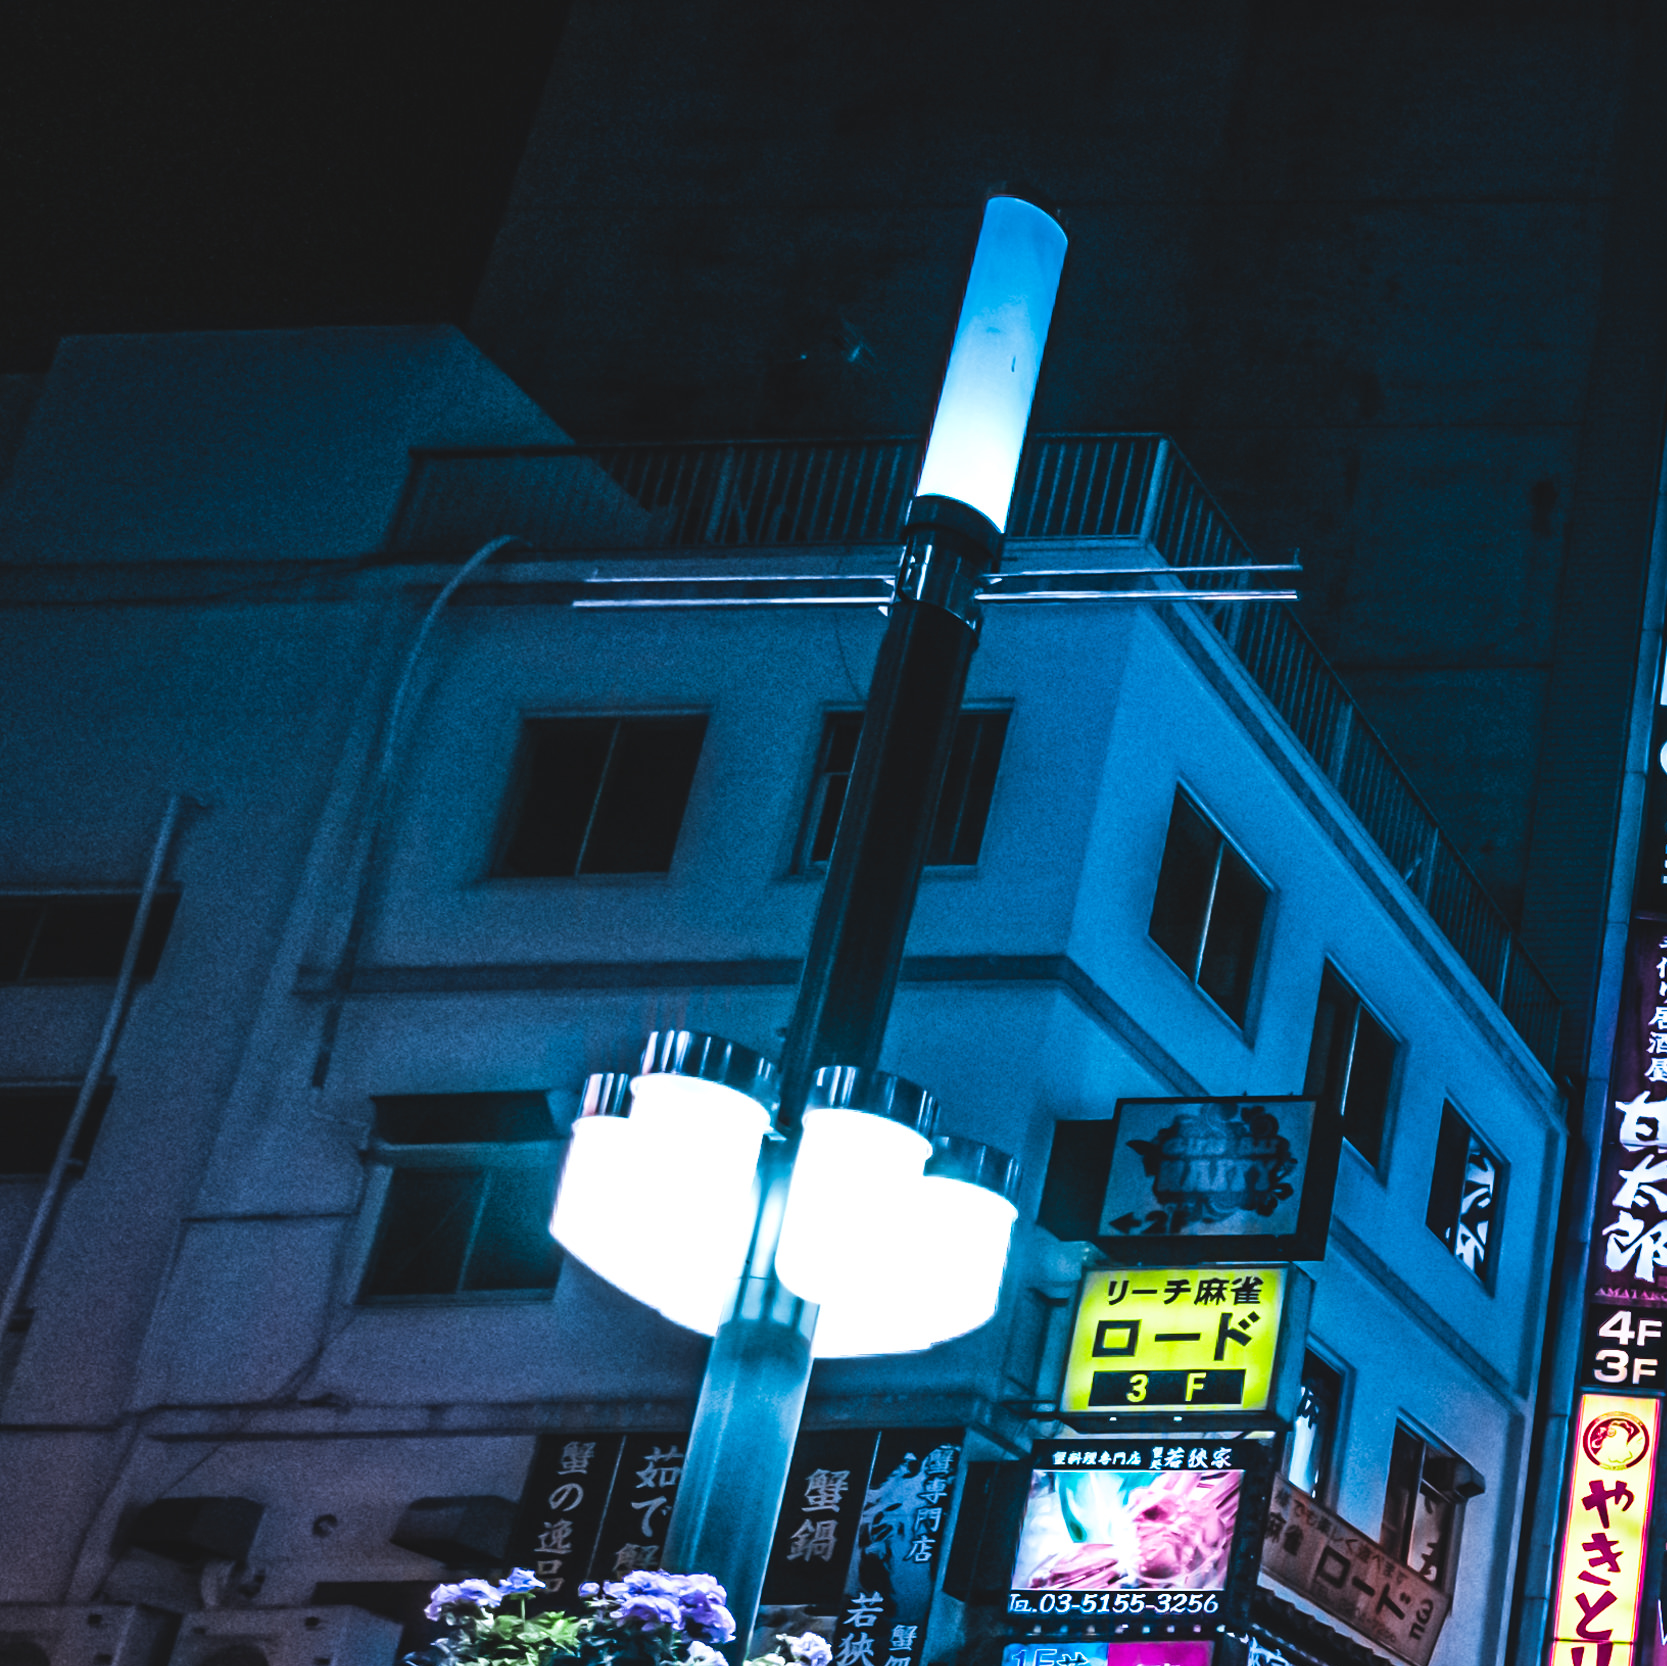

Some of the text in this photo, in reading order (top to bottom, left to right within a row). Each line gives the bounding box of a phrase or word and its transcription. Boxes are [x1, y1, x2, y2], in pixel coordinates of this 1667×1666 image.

[1106, 1276, 1264, 1306] リーチ麻雀
[1092, 1311, 1260, 1361] ロード
[1597, 1309, 1663, 1347] 4F
[1592, 1348, 1659, 1385] 3F
[786, 1468, 852, 1563] 蟹鍋
[1316, 1546, 1406, 1621] ロード
